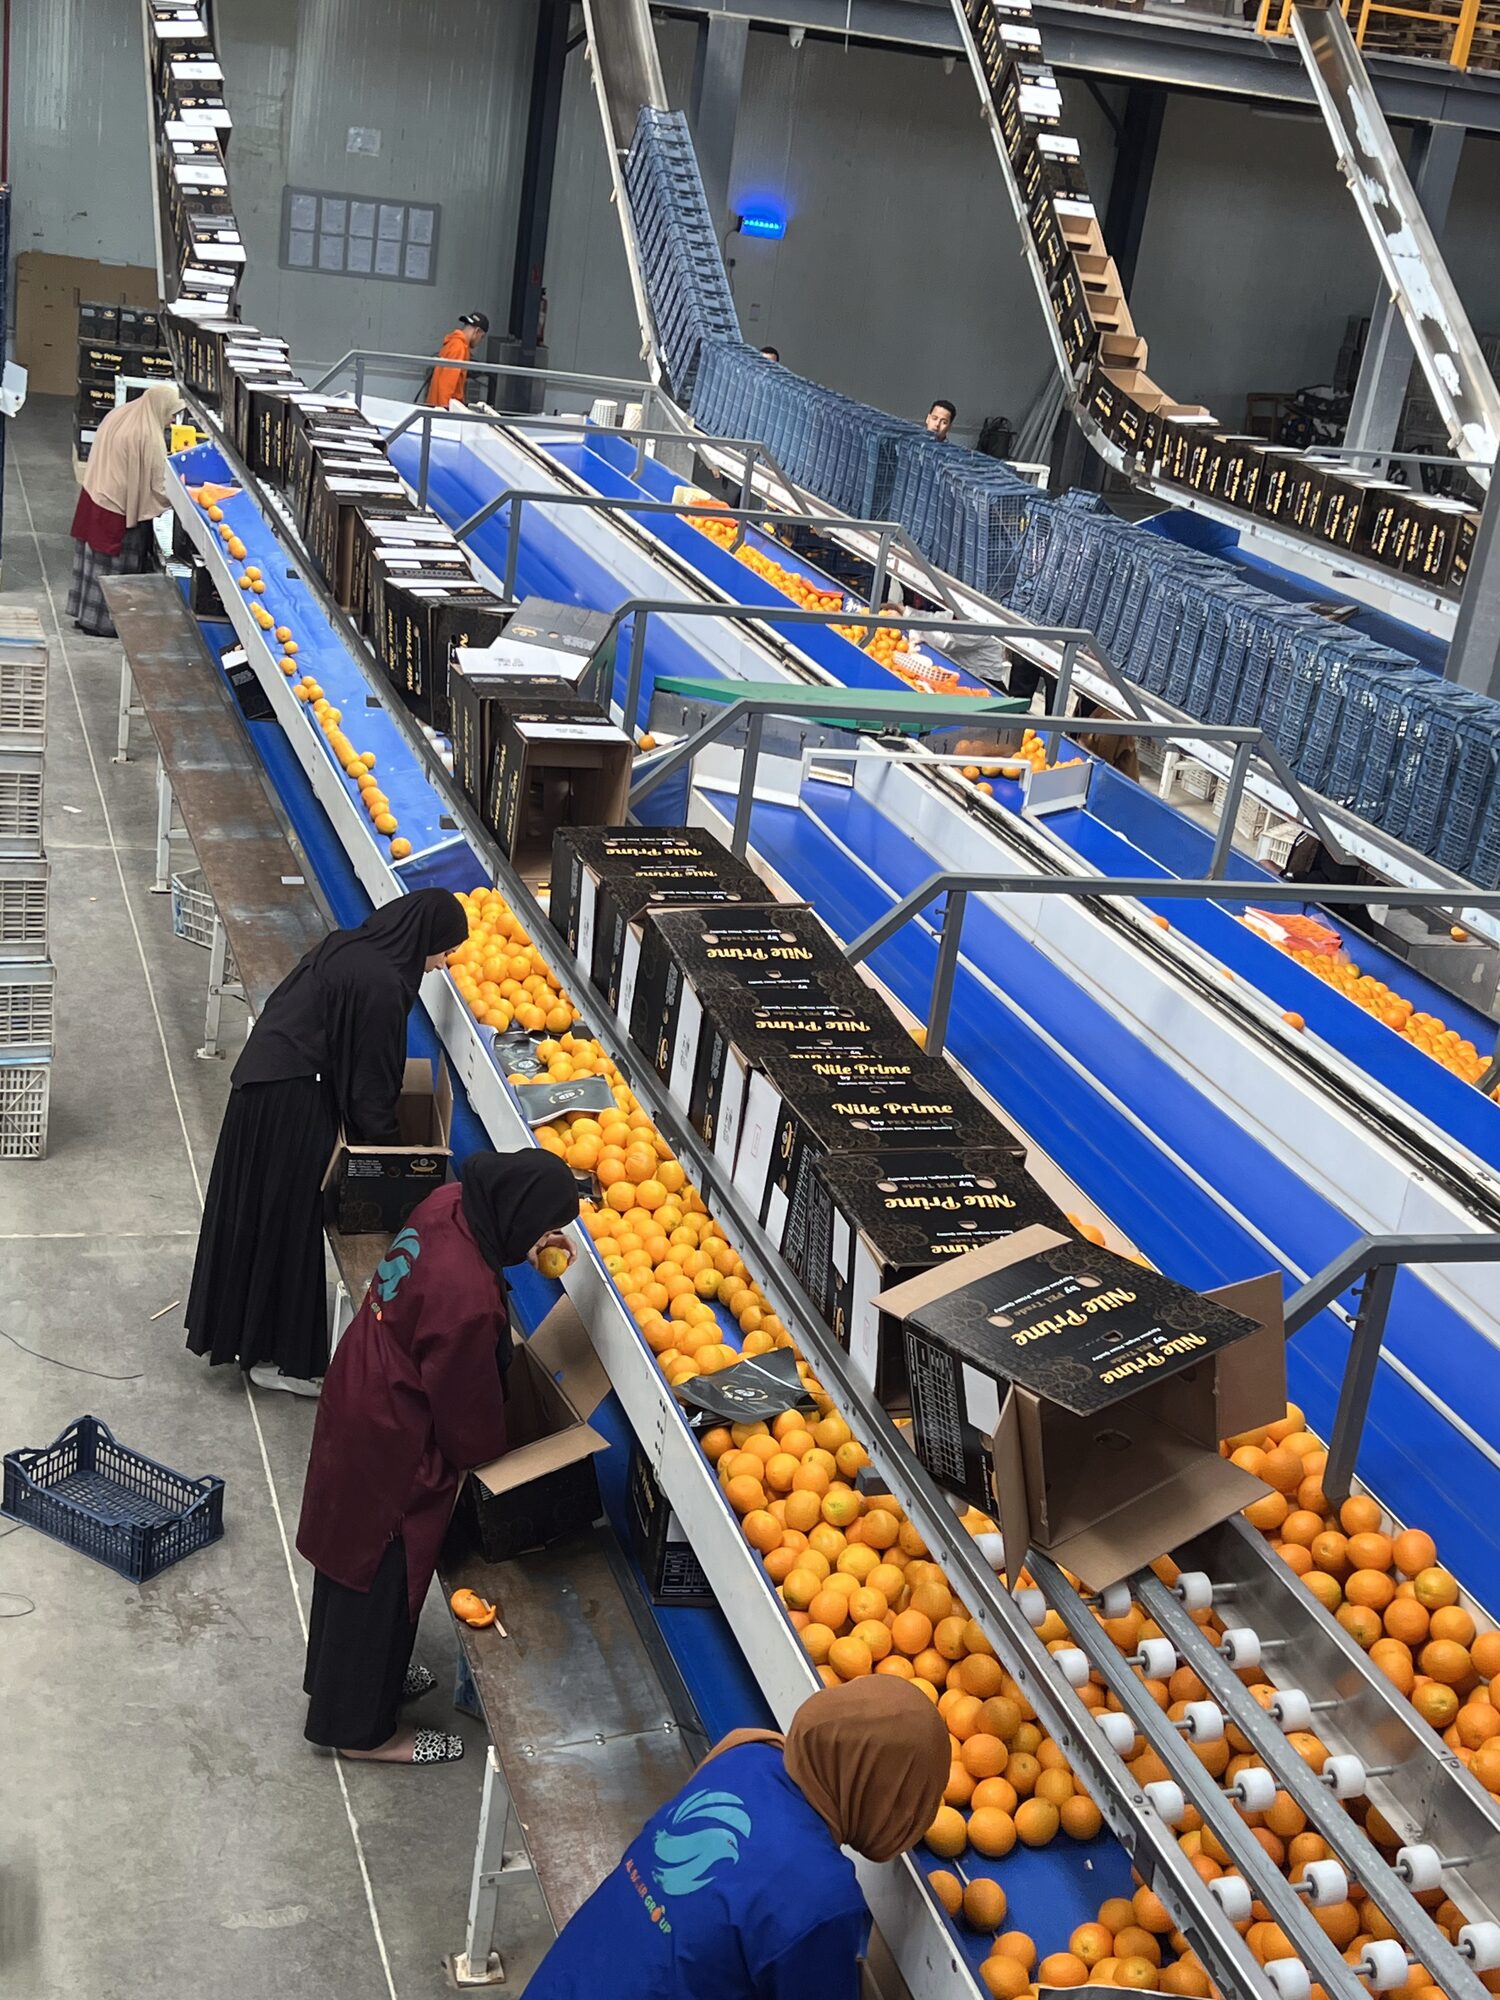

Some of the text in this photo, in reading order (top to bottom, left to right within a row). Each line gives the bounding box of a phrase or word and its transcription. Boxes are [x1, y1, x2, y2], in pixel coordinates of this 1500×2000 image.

[606, 848, 703, 857] Nile Prime
[707, 947, 813, 961] Nile Prime
[755, 1021, 871, 1032] Nile Prime
[812, 1063, 911, 1075] Nile Prime
[831, 1102, 954, 1115] Nile Prime
[959, 1180, 974, 1188] by
[884, 1194, 1017, 1210] Nile Prime
[929, 1243, 980, 1254] rime
[1013, 1285, 1081, 1316] by PEI Trade
[1011, 1287, 1137, 1346] Nile Prime
[1152, 1335, 1168, 1345] by
[1099, 1332, 1207, 1384] Nile Prime
[644, 1895, 672, 1934] GROUP
